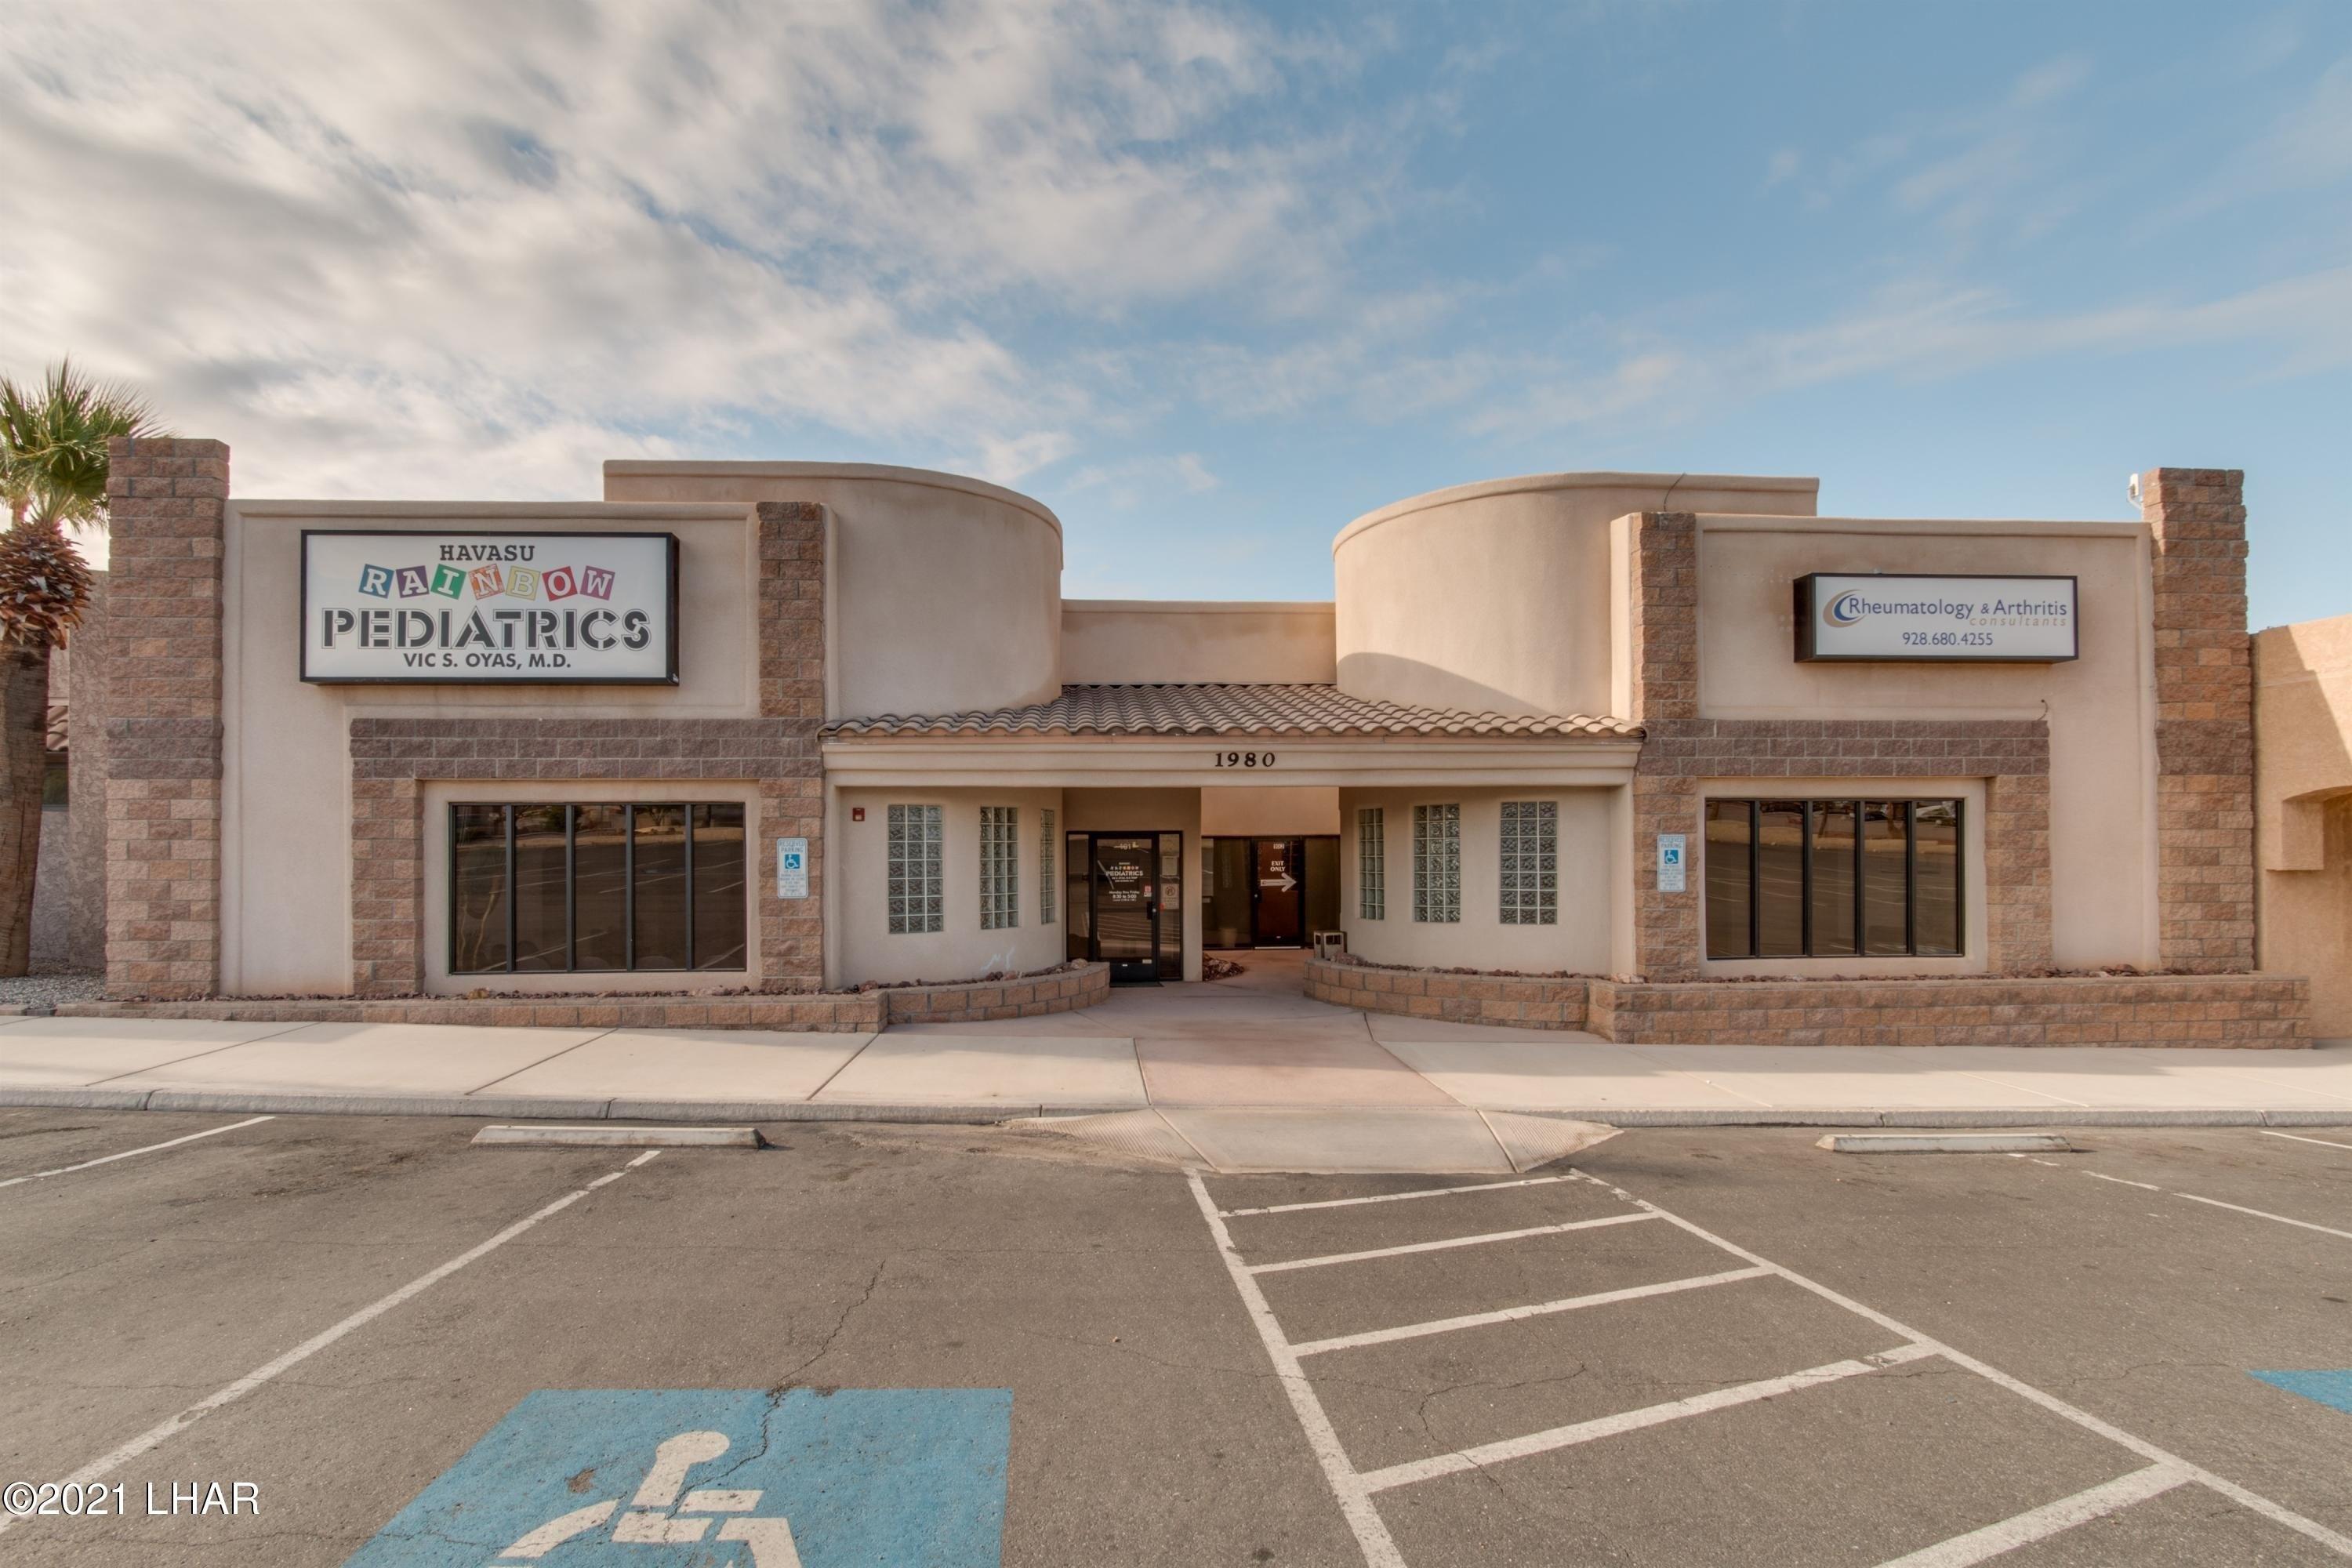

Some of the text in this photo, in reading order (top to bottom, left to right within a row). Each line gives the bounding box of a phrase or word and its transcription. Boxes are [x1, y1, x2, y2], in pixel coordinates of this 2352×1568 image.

[440, 545, 535, 561] HAVASU
[361, 564, 615, 600] RAINBOW
[1849, 598, 2067, 619] Rheumatology & Arthritis
[322, 606, 651, 651] PEDIATRICS
[1969, 615, 2067, 627] consultants
[1902, 632, 1994, 646] 928.680.4255
[403, 653, 572, 670] VIC S. OYAS, M.D.
[1215, 752, 1276, 767] 1980
